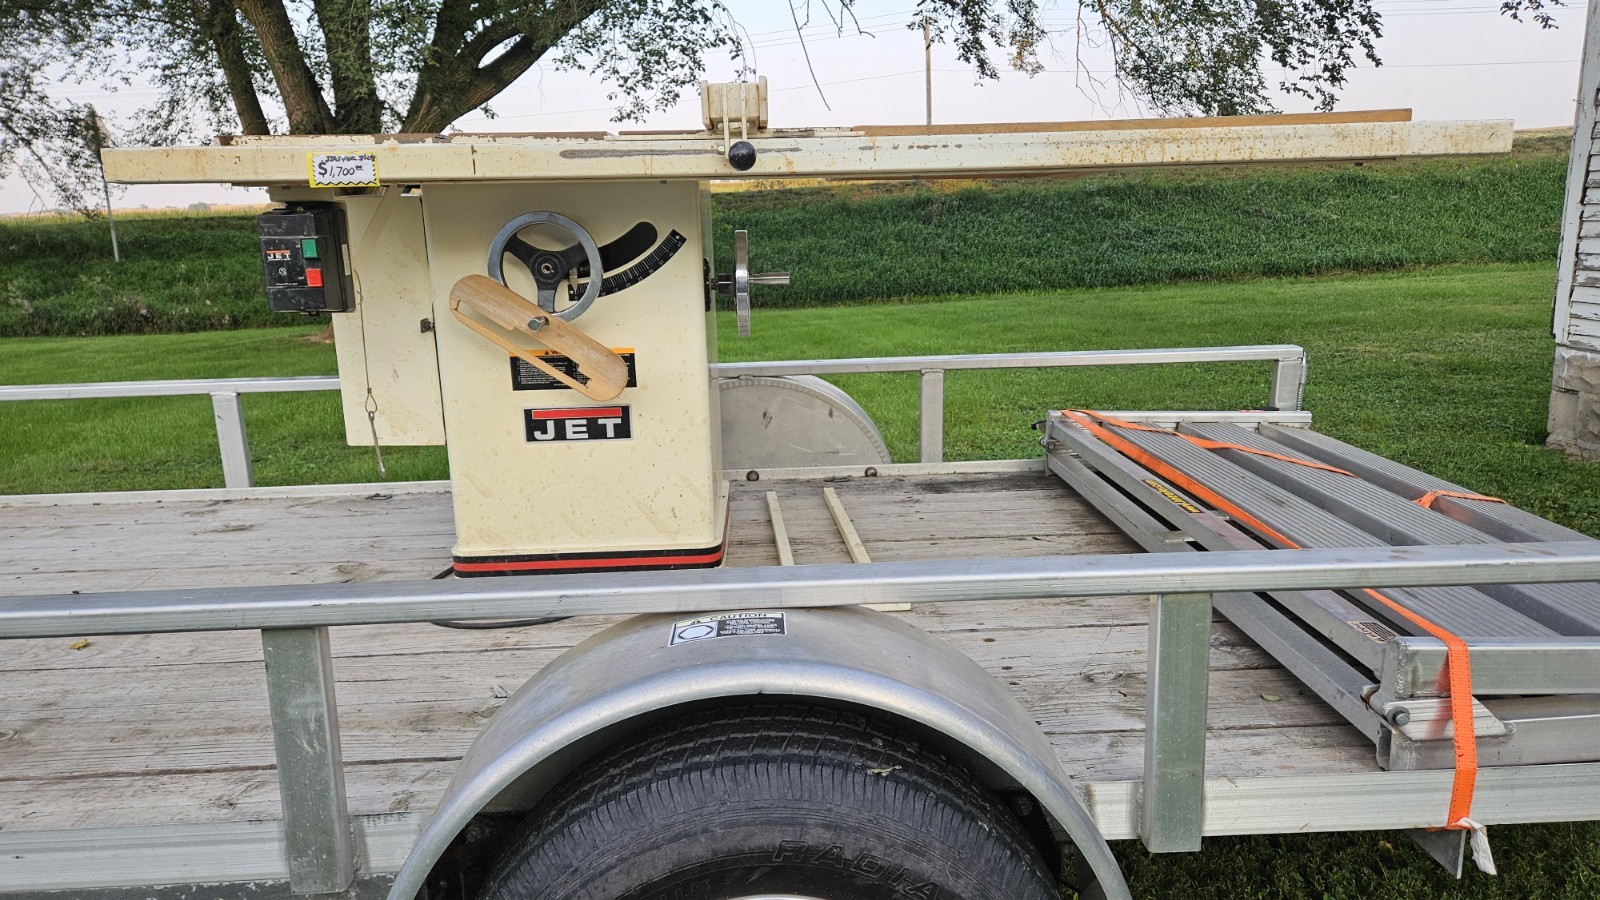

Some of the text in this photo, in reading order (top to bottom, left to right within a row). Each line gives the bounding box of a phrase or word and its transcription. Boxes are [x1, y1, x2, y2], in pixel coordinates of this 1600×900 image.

[318, 160, 355, 178] $1,700
[267, 252, 291, 260] JET
[533, 418, 622, 441] JET
